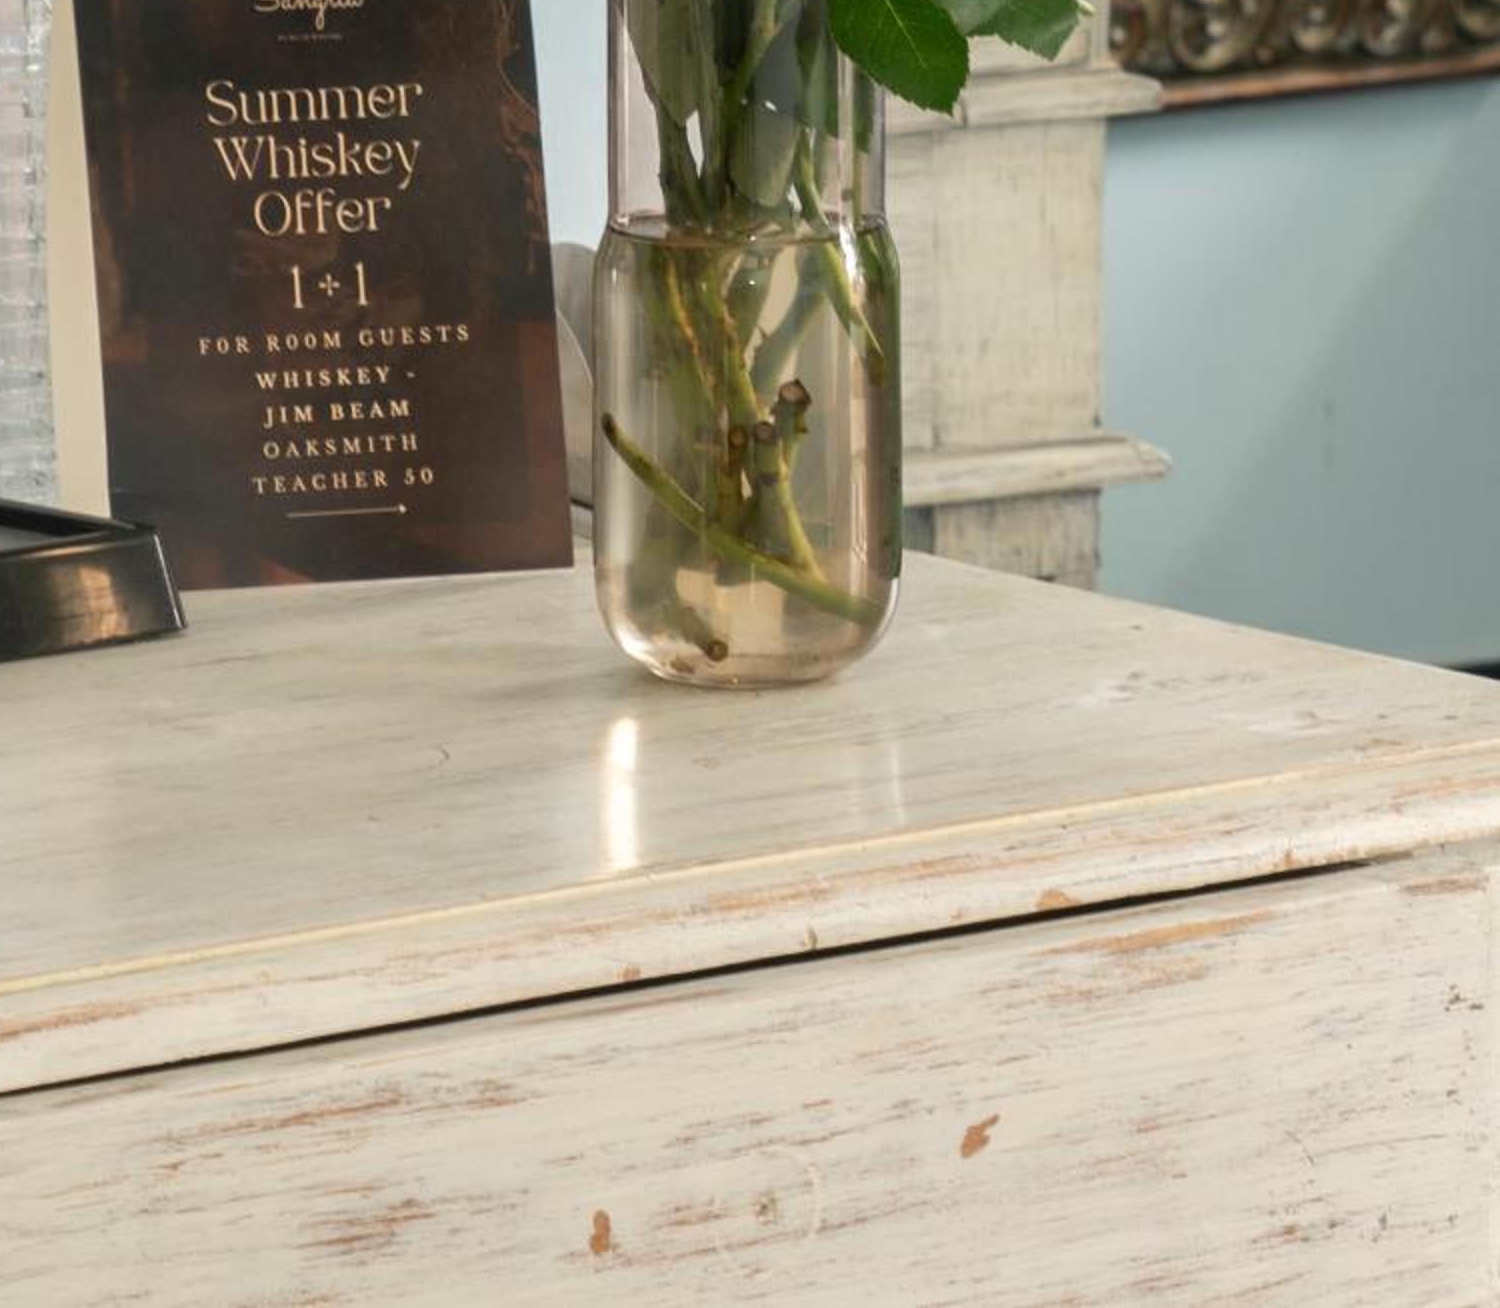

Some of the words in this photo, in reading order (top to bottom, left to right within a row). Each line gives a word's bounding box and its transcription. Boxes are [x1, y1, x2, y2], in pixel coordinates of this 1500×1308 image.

[205, 81, 423, 126] Summer
[213, 131, 421, 192] Whiskey
[254, 188, 392, 235] Offer
[199, 336, 250, 355] FOR
[266, 331, 341, 353] ROOM
[358, 323, 469, 347] GUESTS
[255, 366, 389, 389] WHISKEY
[263, 404, 313, 429] JIM
[330, 399, 409, 421] BEAM
[262, 433, 417, 459] OAKSMITH
[252, 469, 388, 495] TEACHER
